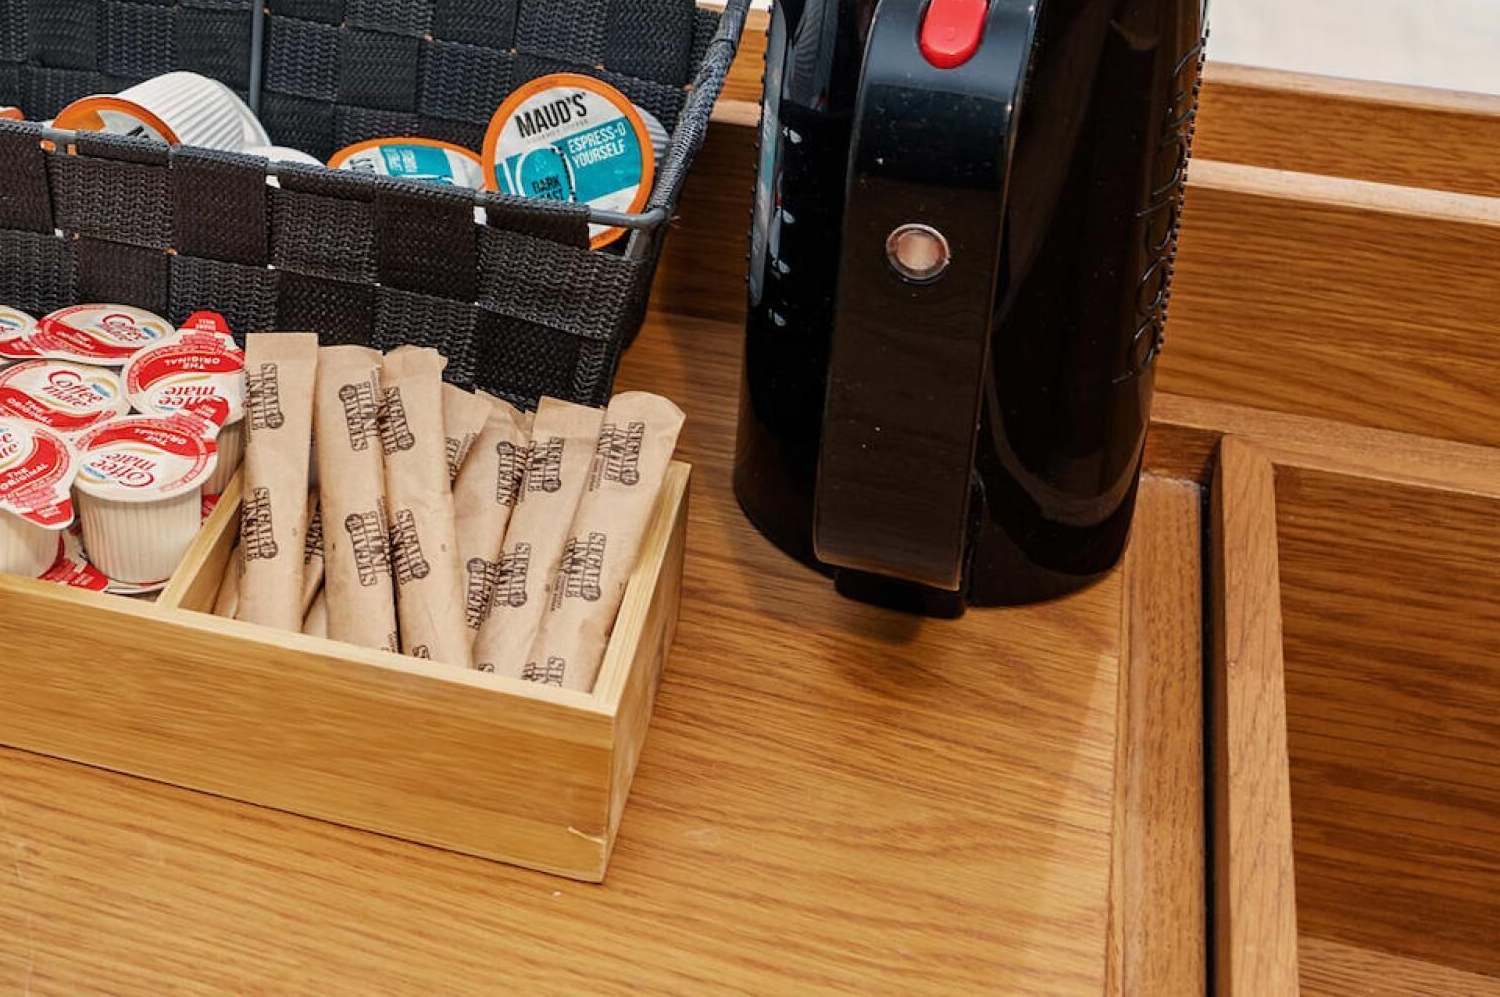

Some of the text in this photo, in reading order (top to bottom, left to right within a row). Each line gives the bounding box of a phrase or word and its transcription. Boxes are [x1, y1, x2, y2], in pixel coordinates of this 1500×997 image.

[515, 92, 587, 138] MAUD'S
[566, 121, 627, 154] ESPRESS-O
[571, 140, 626, 169] YOURSELF
[531, 173, 562, 195] DARK
[164, 356, 220, 367] ORIGINAL
[42, 386, 87, 407] mate
[48, 370, 105, 402] Coffee
[164, 386, 216, 395] mate
[260, 363, 281, 413] SUGAR
[251, 392, 266, 430] THE
[345, 399, 368, 451] SUGAR
[105, 454, 157, 471] mate
[622, 422, 645, 472] SUGAR
[90, 461, 155, 488] Coffee
[496, 454, 515, 506] SUGAR
[529, 463, 547, 493] THE
[604, 448, 623, 483] THE
[253, 488, 274, 544] SUGAR
[396, 510, 424, 563] SUGAR
[350, 531, 378, 586] SUGAR
[510, 542, 531, 593] SUGAR
[583, 532, 606, 587] SUGAR
[565, 562, 586, 598] THE
